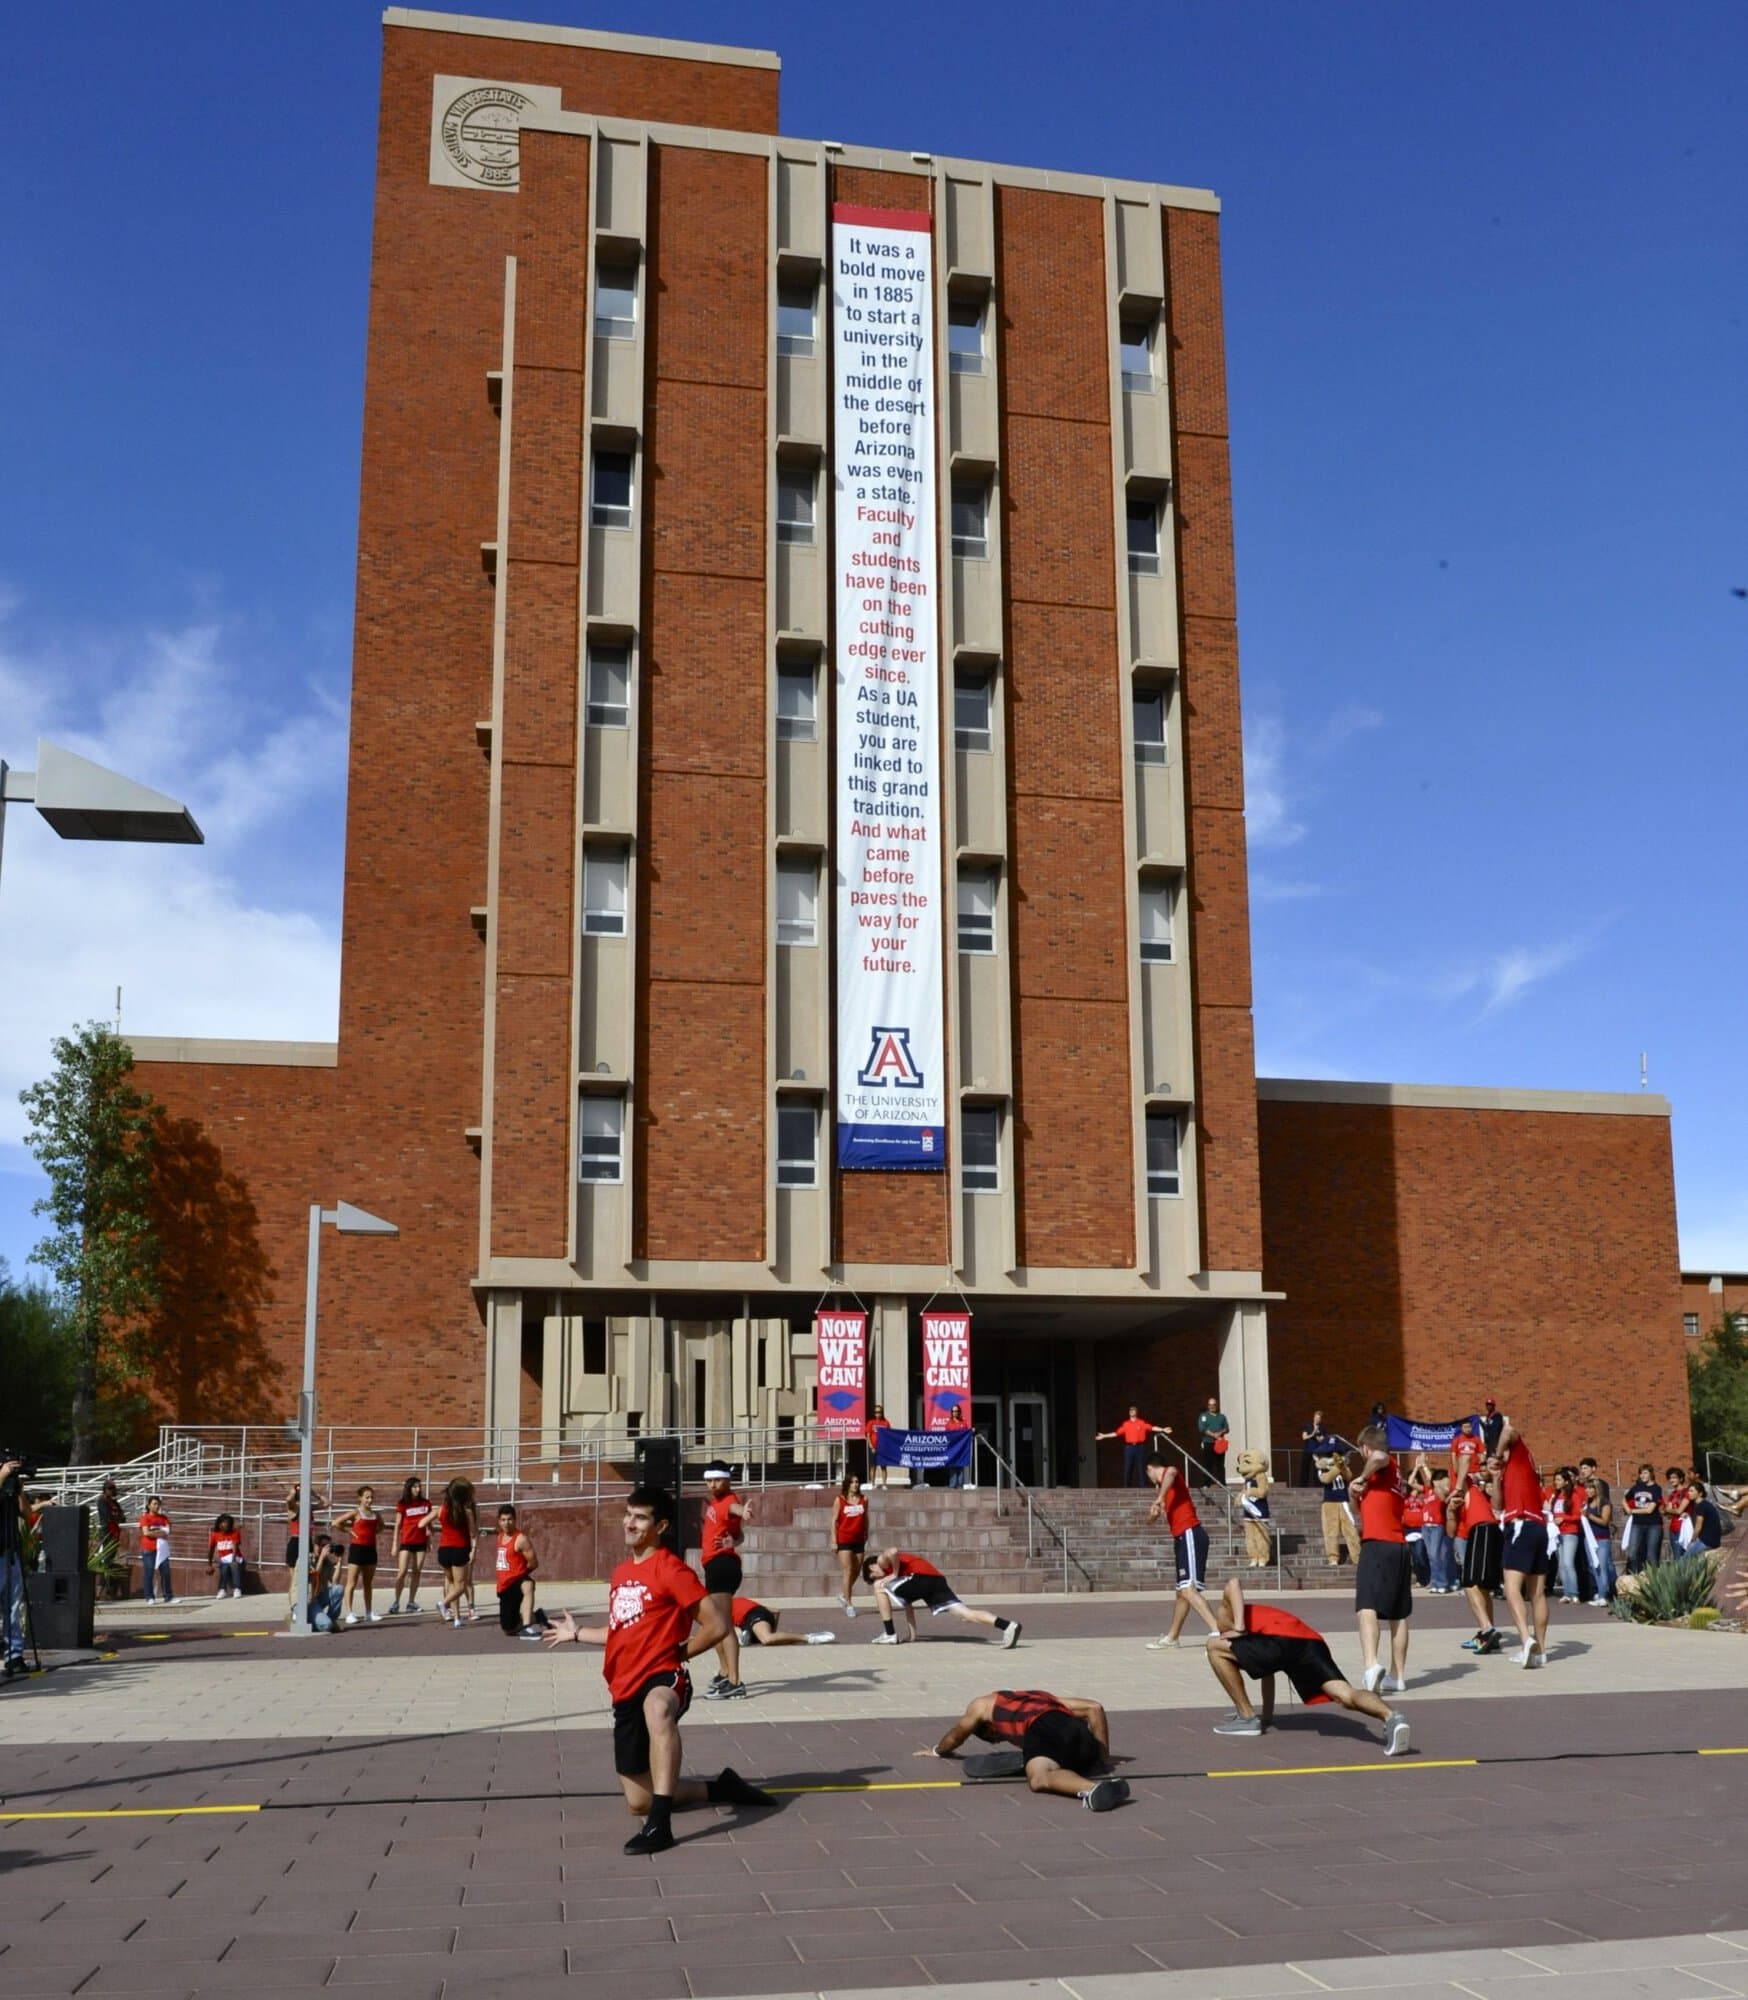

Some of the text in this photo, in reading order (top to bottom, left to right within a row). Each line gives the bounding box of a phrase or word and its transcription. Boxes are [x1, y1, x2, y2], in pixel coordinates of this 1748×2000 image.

[850, 238, 915, 259] It was a
[840, 259, 925, 282] bold move
[853, 283, 914, 303] in 1885
[846, 305, 920, 325] to start a
[843, 329, 923, 352] university
[861, 351, 908, 368] in the
[846, 373, 922, 394] middle of
[844, 394, 925, 416] the desert
[859, 417, 911, 436] before
[854, 440, 915, 460] Arizona
[848, 464, 923, 483] was even
[856, 484, 915, 504] a state.
[857, 506, 915, 530] Faculty
[872, 532, 901, 547] and
[852, 551, 920, 573] students
[846, 573, 927, 596] have been
[862, 598, 911, 616] on the
[859, 619, 914, 643] cutting
[848, 641, 926, 663] edge ever
[865, 663, 911, 684] since.
[857, 685, 918, 707] As a UA
[856, 709, 920, 732] student,
[859, 733, 917, 752] you are
[854, 752, 923, 774] linked to
[848, 775, 928, 797] this grand
[853, 798, 924, 819] tradition.
[851, 820, 927, 841] And what
[866, 848, 910, 863] came
[863, 867, 914, 885] before
[851, 891, 928, 907] paves the
[858, 913, 919, 930] way for
[872, 937, 907, 952] your
[863, 955, 916, 973] future.
[857, 1026, 924, 1088] A
[845, 1094, 938, 1108] THE UNIVERSITY
[855, 1108, 928, 1121] OF ARIZONA
[821, 1318, 863, 1338] NOW
[926, 1320, 967, 1339] NOW
[820, 1338, 863, 1366] WE
[925, 1339, 968, 1366] WE
[820, 1366, 864, 1388] CAN!
[926, 1367, 969, 1388] CAN!
[904, 1434, 948, 1444] ARIZONA
